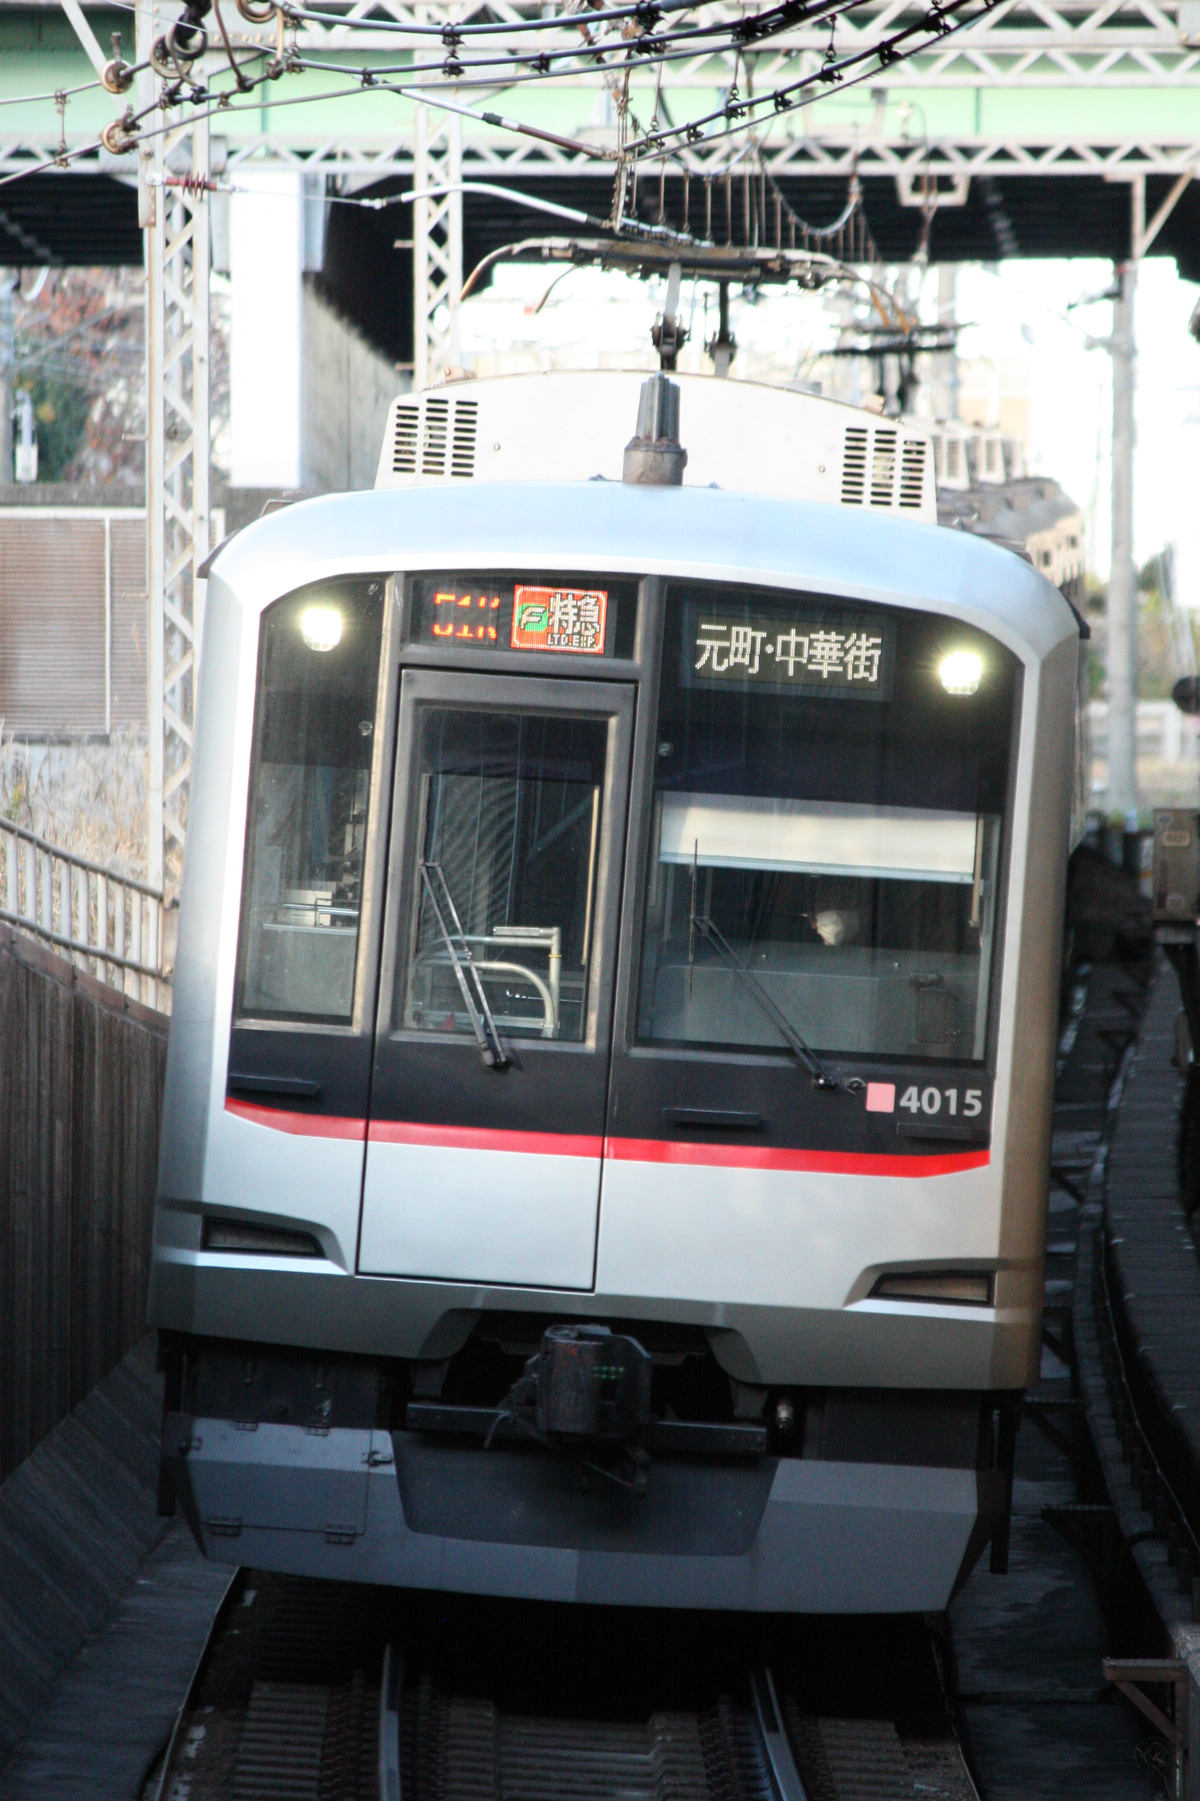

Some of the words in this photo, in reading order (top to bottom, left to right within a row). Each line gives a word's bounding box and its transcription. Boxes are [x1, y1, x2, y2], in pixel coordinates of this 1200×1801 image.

[549, 592, 600, 635] 特急
[695, 624, 882, 682] 元町・中華街
[899, 1086, 983, 1118] 4015
